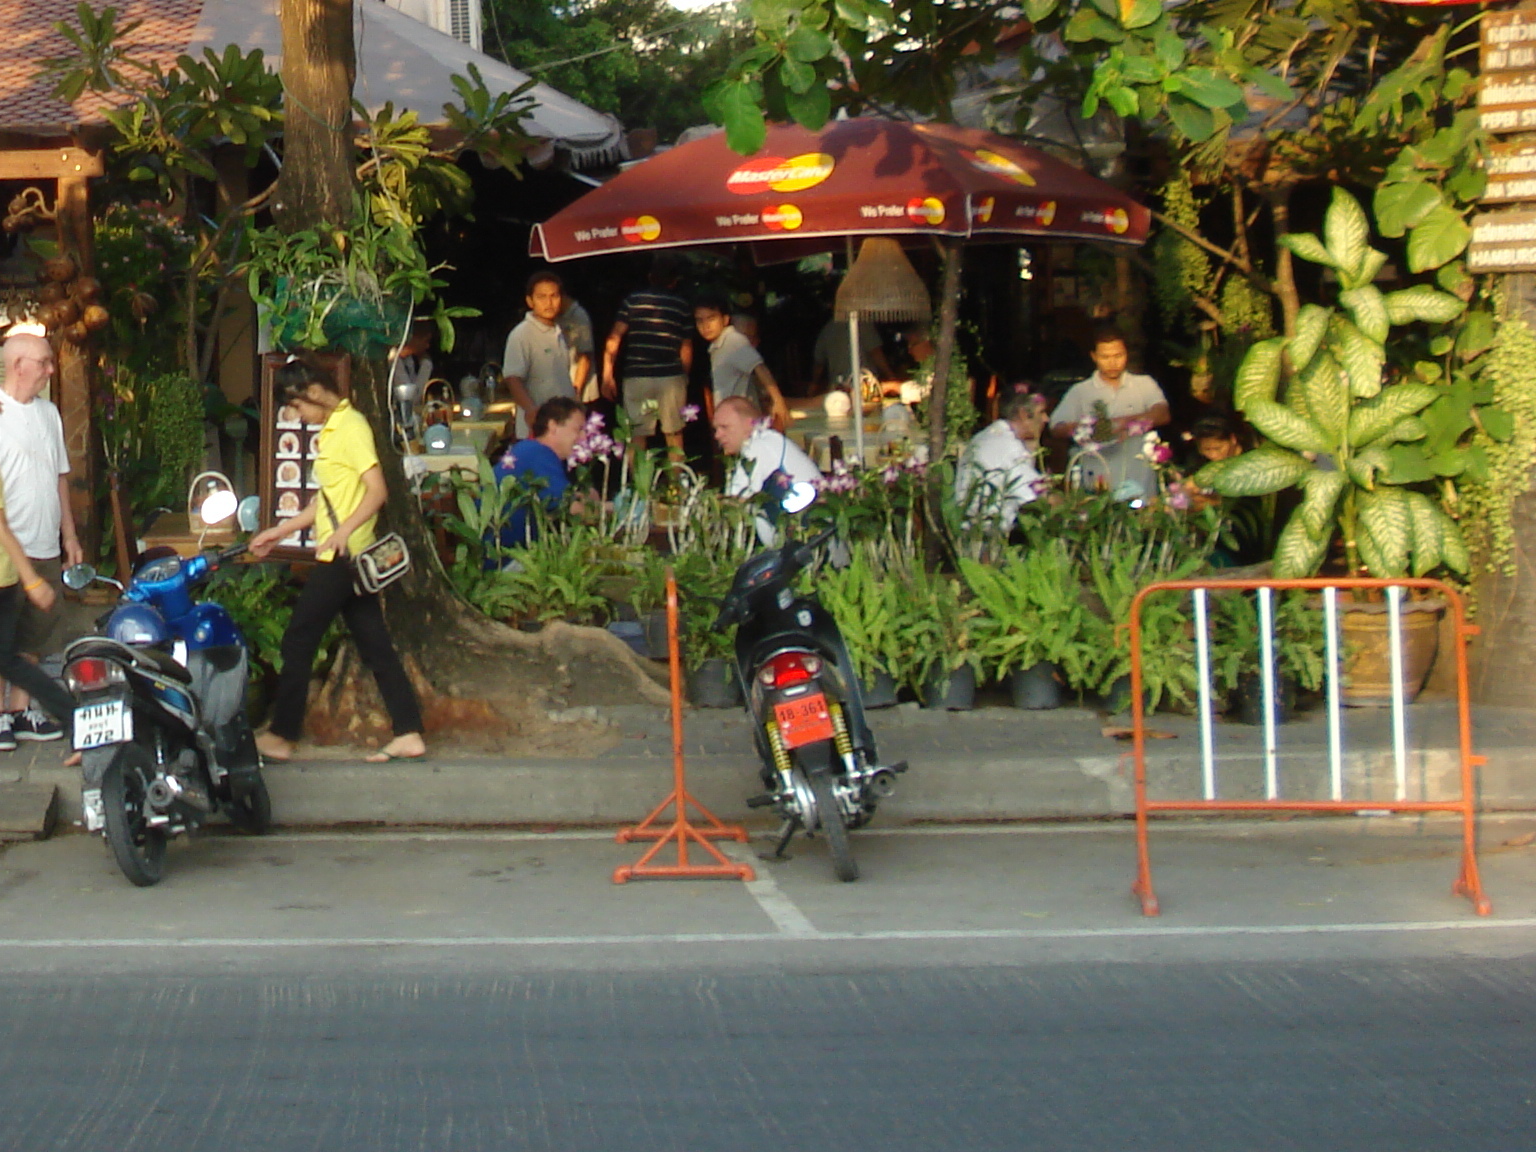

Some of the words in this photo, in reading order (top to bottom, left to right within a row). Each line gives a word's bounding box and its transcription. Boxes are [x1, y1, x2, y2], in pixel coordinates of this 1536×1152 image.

[861, 205, 877, 217] We
[878, 205, 904, 217] Prefer
[716, 215, 732, 227] We
[733, 214, 759, 226] Prefer
[574, 229, 591, 242] We
[592, 226, 618, 238] Prefer
[83, 729, 114, 746] 472
